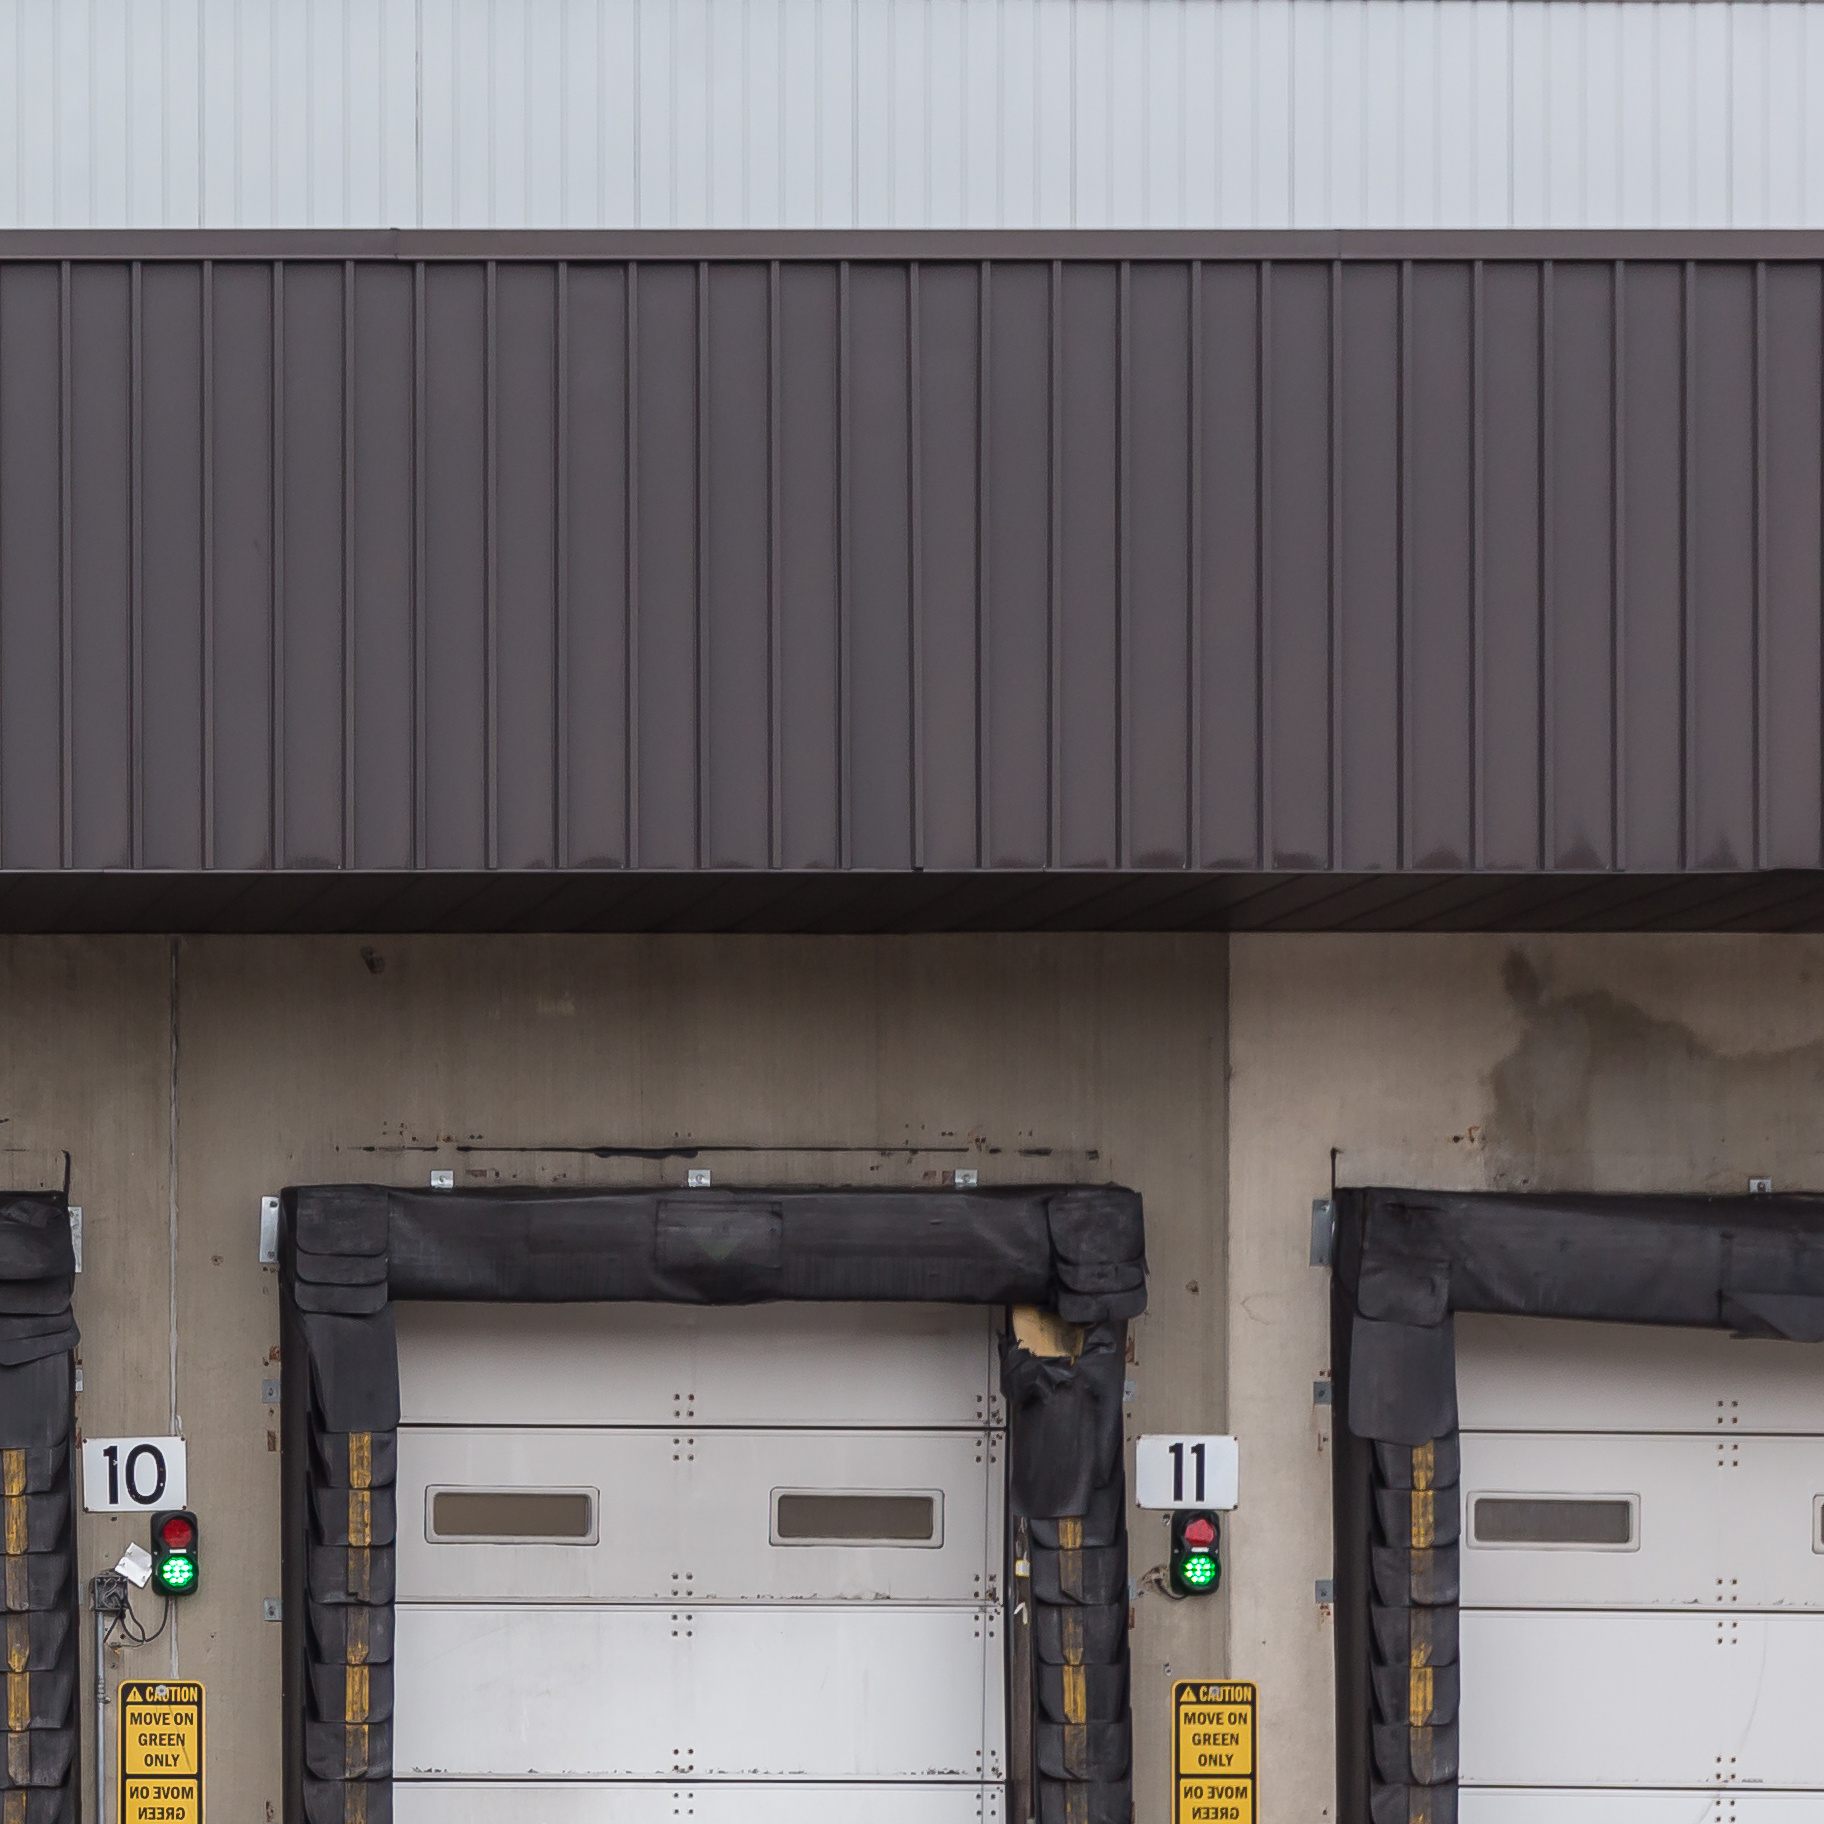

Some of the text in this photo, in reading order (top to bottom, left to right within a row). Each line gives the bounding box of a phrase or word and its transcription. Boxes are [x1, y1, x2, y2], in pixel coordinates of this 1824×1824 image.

[103, 1444, 166, 1504] 10
[1169, 1443, 1205, 1501] 11
[130, 1713, 193, 1725] MOVE ON
[1184, 1712, 1247, 1725] MOVE ON
[138, 1733, 185, 1746] GREEN
[1192, 1733, 1239, 1746] GREEN
[144, 1754, 179, 1767] ONLY
[1198, 1754, 1233, 1766] ONLY
